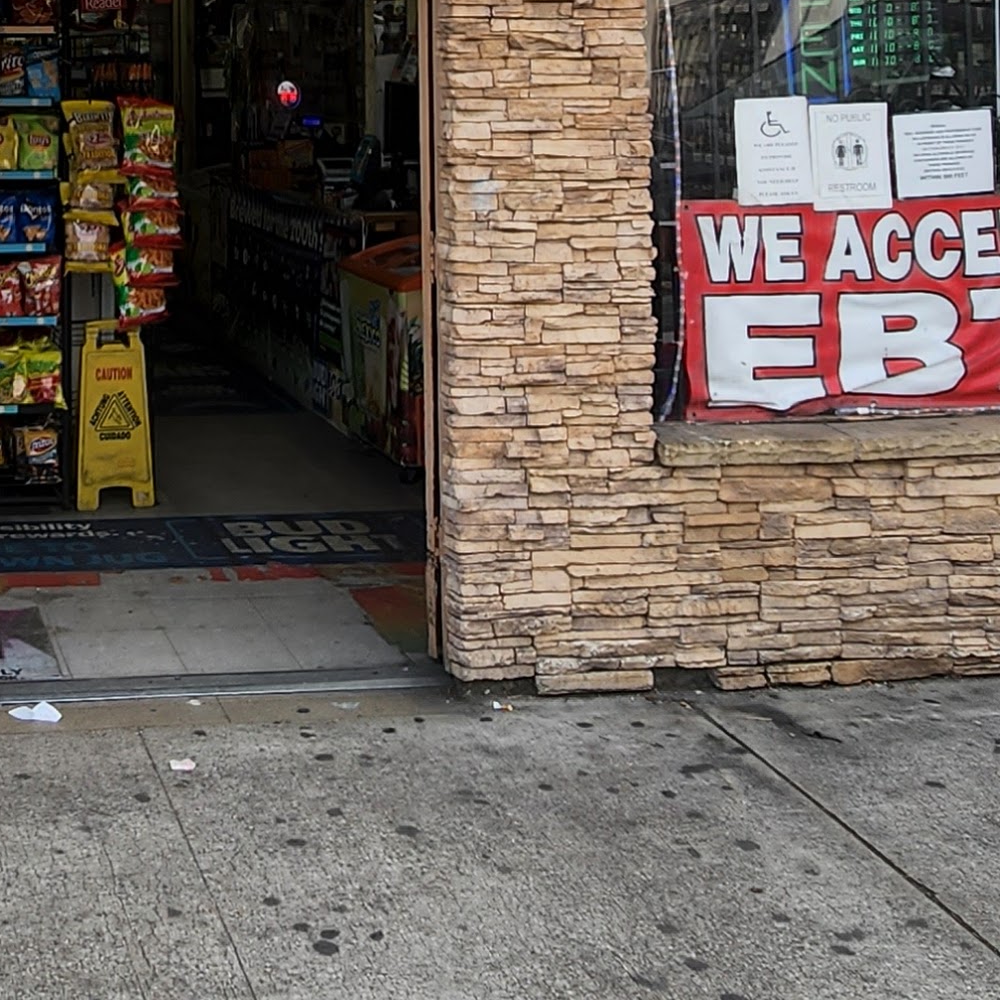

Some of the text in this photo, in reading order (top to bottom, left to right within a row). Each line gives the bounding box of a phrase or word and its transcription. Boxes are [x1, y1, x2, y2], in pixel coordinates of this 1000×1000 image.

[826, 113, 871, 123] NO PUBLIC
[828, 182, 877, 193] RESTROOM
[696, 209, 1000, 283] WE ACCE
[95, 367, 133, 381] CAUTION
[100, 431, 131, 440] CUIDADO
[222, 519, 371, 537] BUD
[220, 533, 399, 554] LIGHT
